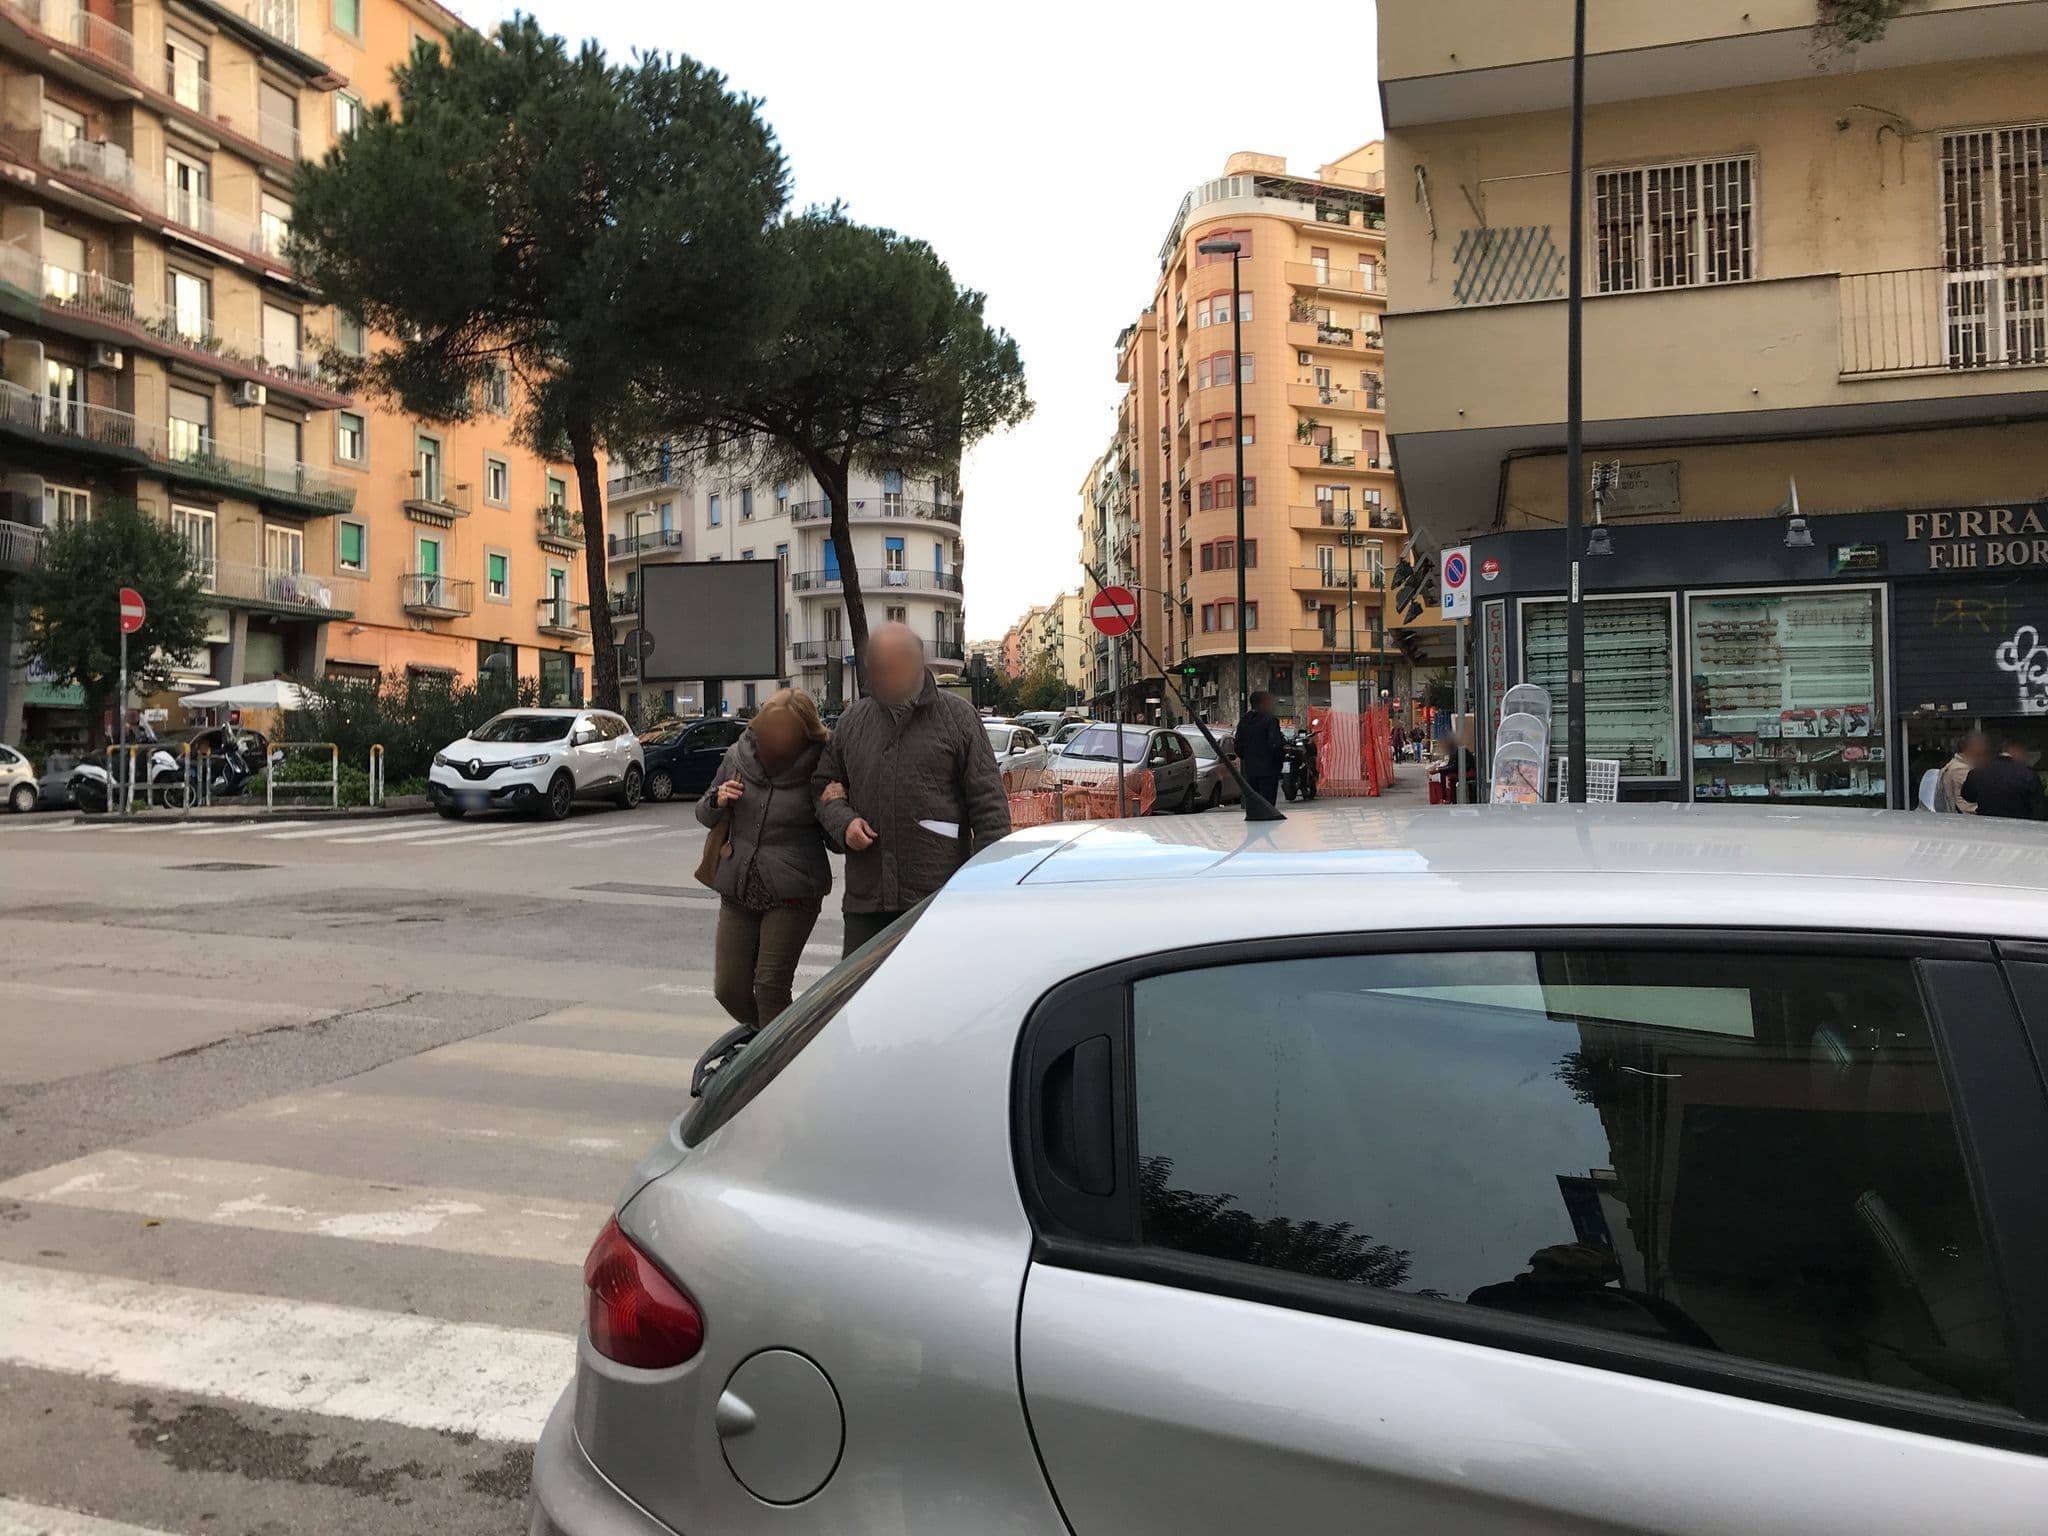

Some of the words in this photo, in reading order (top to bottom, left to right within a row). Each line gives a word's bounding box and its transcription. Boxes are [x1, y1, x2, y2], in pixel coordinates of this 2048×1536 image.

[1928, 542, 1978, 569] F.lli
[1985, 540, 2048, 567] BOR
[1490, 608, 1503, 678] CHIAVI
